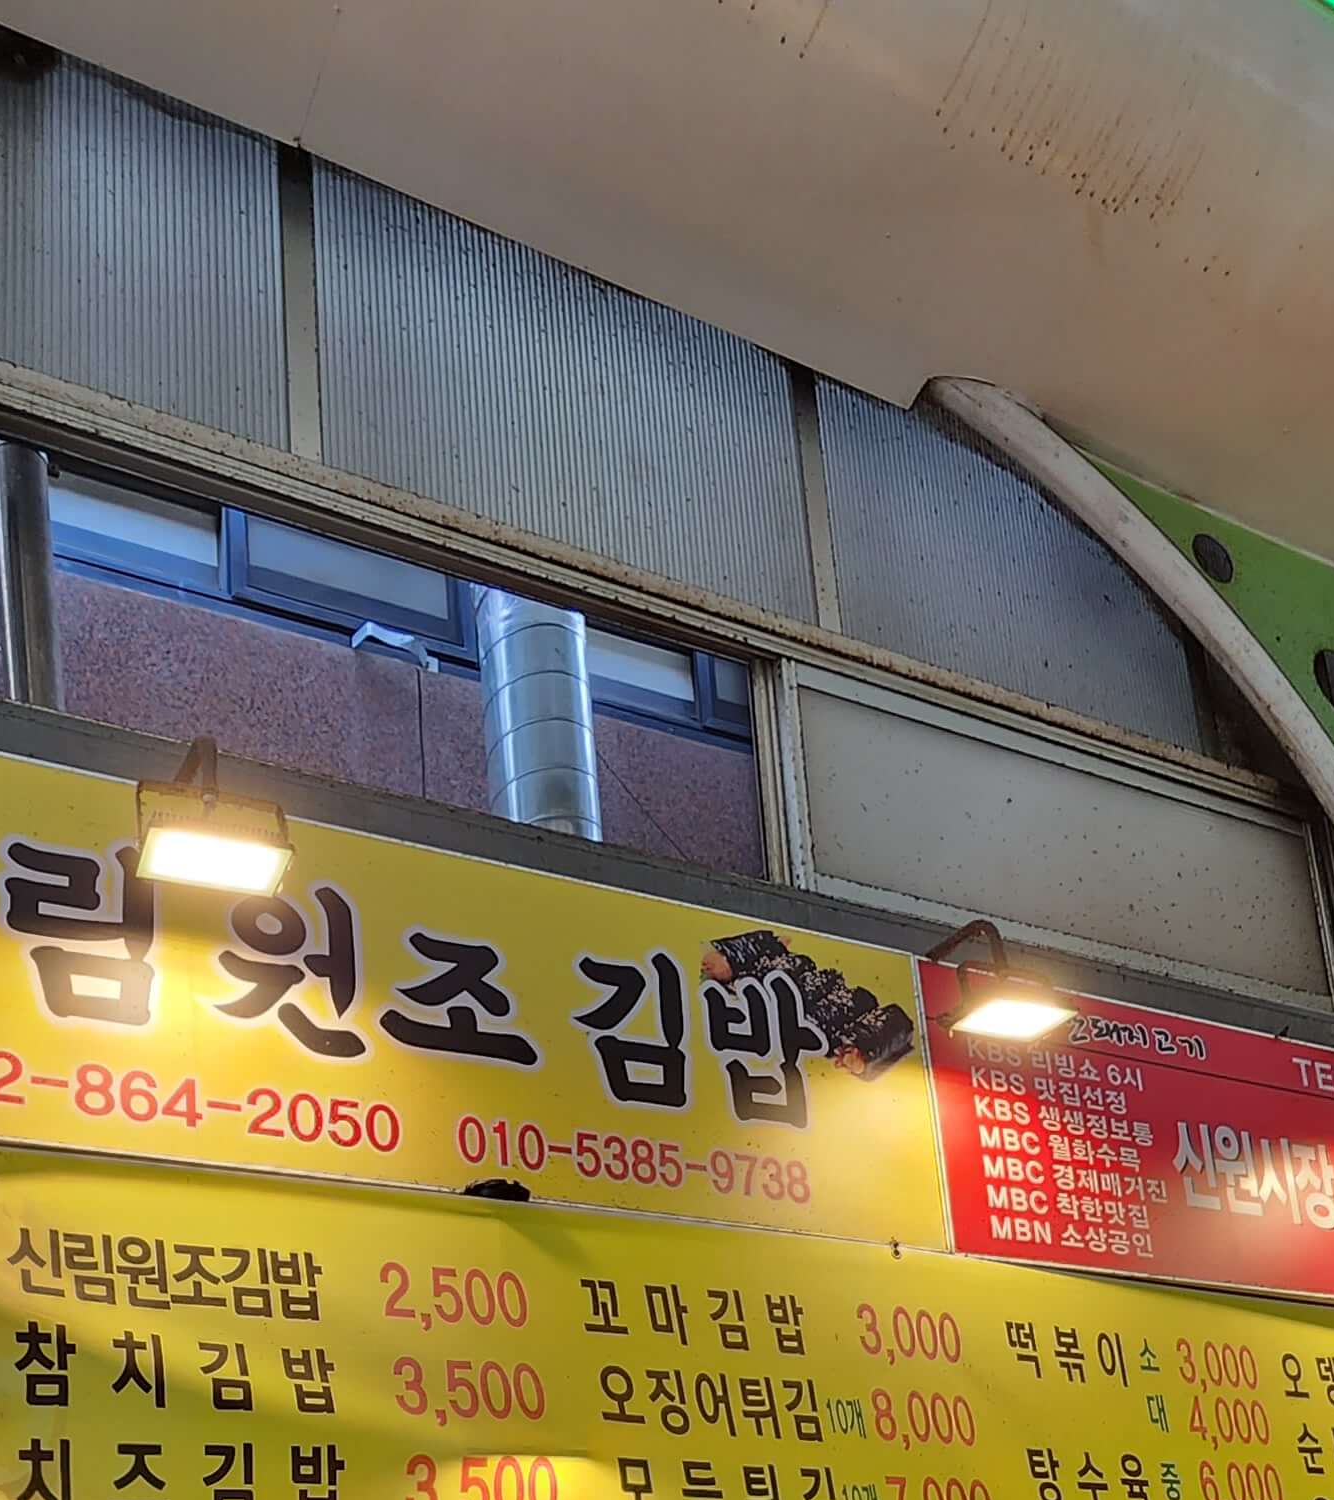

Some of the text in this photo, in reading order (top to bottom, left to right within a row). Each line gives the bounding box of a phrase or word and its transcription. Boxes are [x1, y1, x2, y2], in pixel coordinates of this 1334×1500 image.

[571, 951, 827, 1129] 김밥
[970, 1065, 1127, 1115] KBS 맛집선정
[1031, 1048, 1101, 1084] 리빙쇼
[1106, 1063, 1144, 1092] 6시
[974, 1095, 1155, 1148] KBS 생생정보통
[978, 1124, 1141, 1173] MBC 월화수목
[457, 1116, 812, 1204] 010-5385-9738
[982, 1154, 1168, 1205] MBC 경제매거진
[986, 1184, 1150, 1231] MBC 착한맛집
[990, 1215, 1155, 1259] MBN 소상공인
[6, 1225, 530, 1333] 신림원조김밥 2,500
[579, 1278, 963, 1367] 꼬마김밥 3,000
[391, 1355, 547, 1428] 3,500
[1139, 1337, 1162, 1374] 소
[1176, 1336, 1258, 1393] 3,000
[598, 1363, 977, 1452] 오징어튀김 10개 8,000
[1145, 1393, 1270, 1451] 대 4,000
